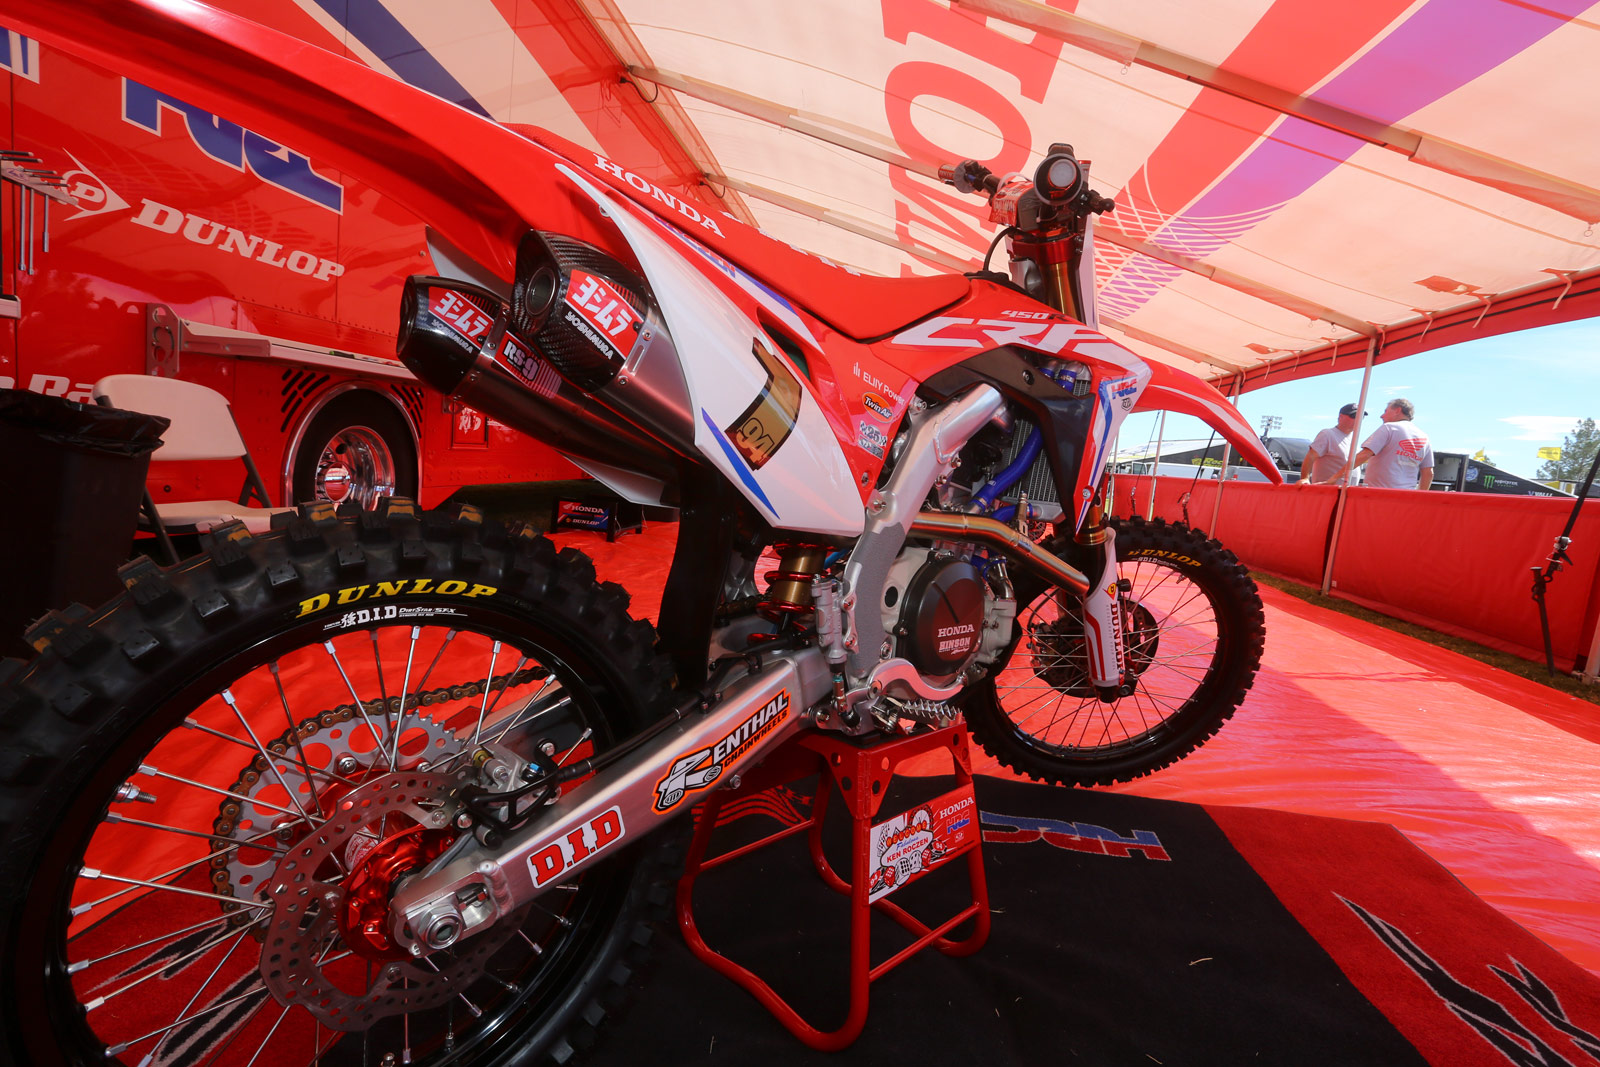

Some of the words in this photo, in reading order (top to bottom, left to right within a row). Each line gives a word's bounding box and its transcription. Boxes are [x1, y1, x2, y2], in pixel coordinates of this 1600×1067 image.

[593, 153, 726, 239] HONDA
[130, 198, 345, 282] DUNLOP
[1001, 310, 1069, 322] 450R
[431, 319, 474, 354] YOSHIMURA
[564, 311, 614, 360] YOSHIMURA
[891, 316, 1107, 354] CRF
[864, 396, 881, 412] Twin
[571, 504, 604, 514] HONDA
[572, 518, 600, 526] DUNLOP
[295, 578, 498, 618] DUNLOP
[357, 605, 397, 624] D.I.D
[937, 623, 975, 638] HONDA
[939, 637, 971, 651] HINSON
[723, 708, 788, 768] CHAINWHEELS
[940, 796, 974, 820] HONDA
[529, 809, 622, 887] D.I.D
[886, 850, 901, 863] KEN
[902, 837, 929, 855] ROCZEN
